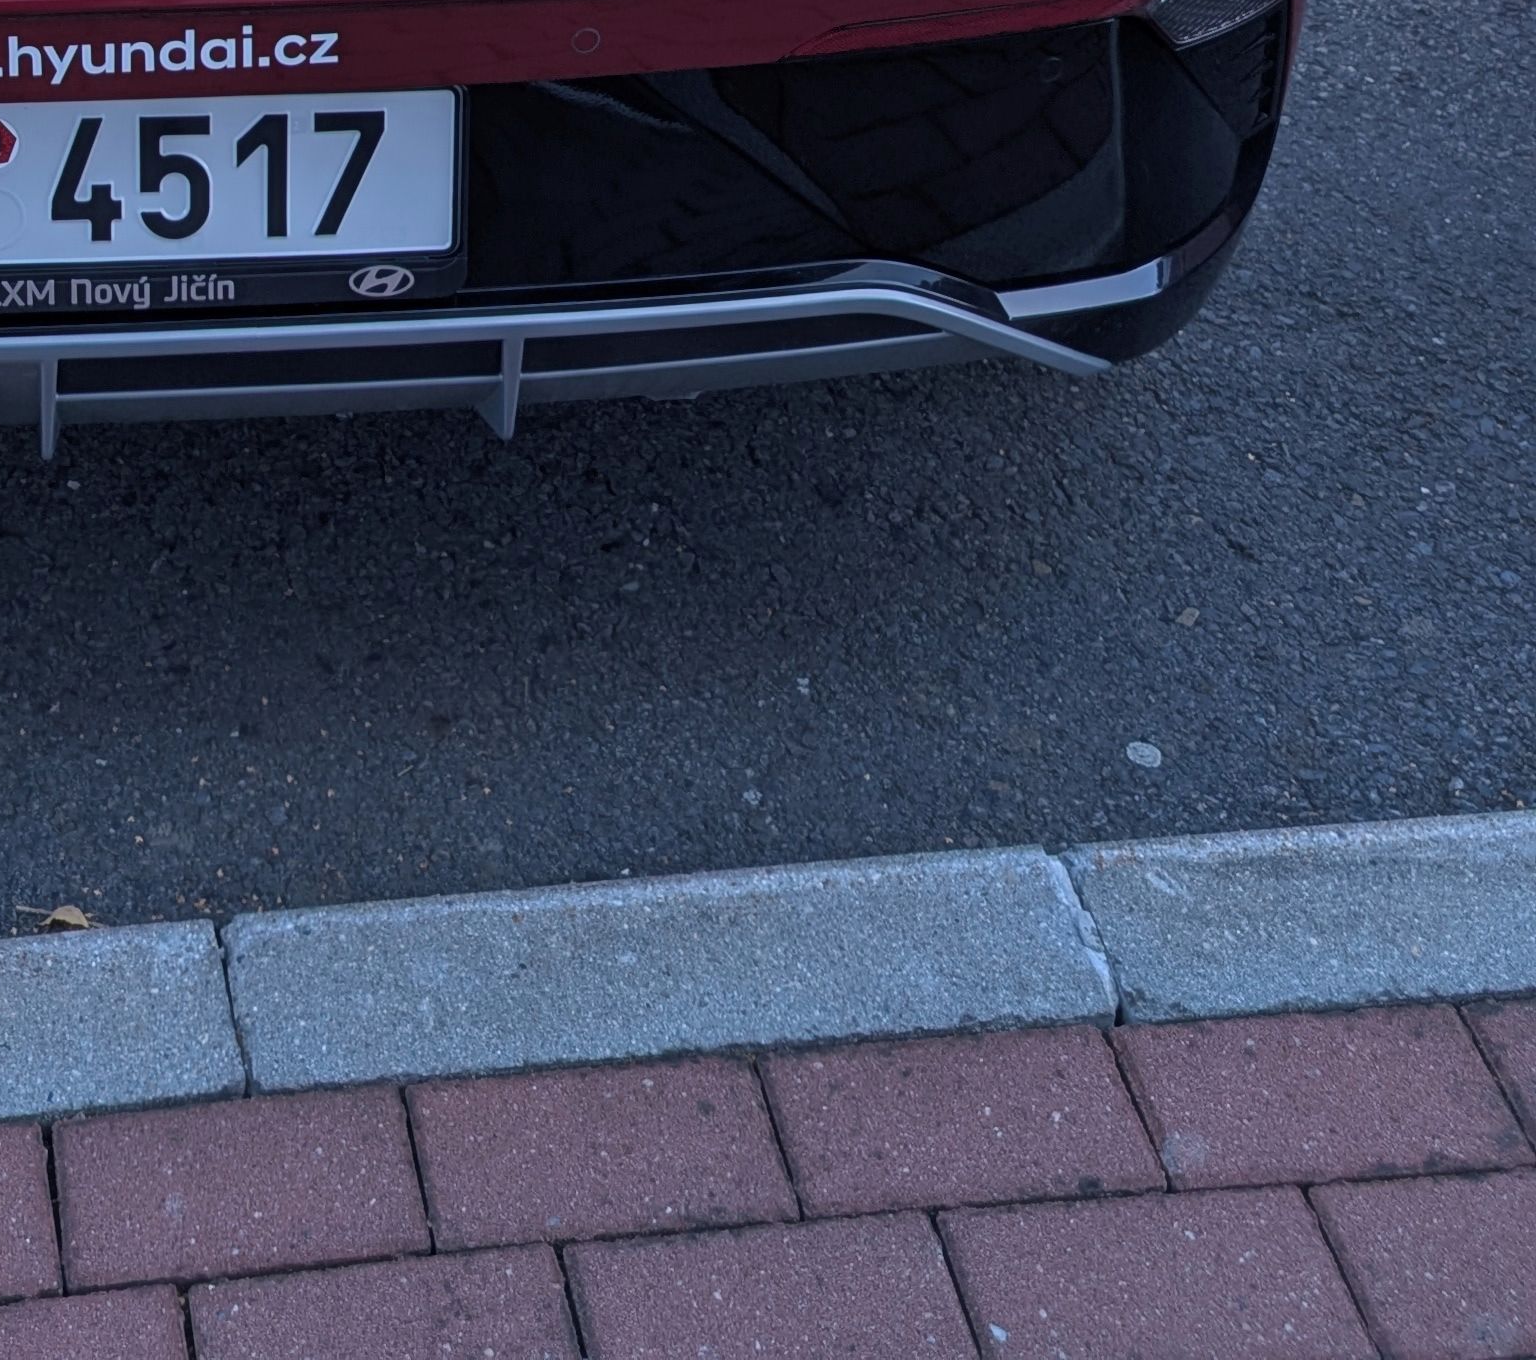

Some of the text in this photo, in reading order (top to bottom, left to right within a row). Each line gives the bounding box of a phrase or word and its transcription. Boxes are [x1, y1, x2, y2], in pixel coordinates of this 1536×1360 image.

[51, 110, 386, 242] 4517
[70, 276, 152, 311] Nový
[163, 273, 236, 303] Jičín
